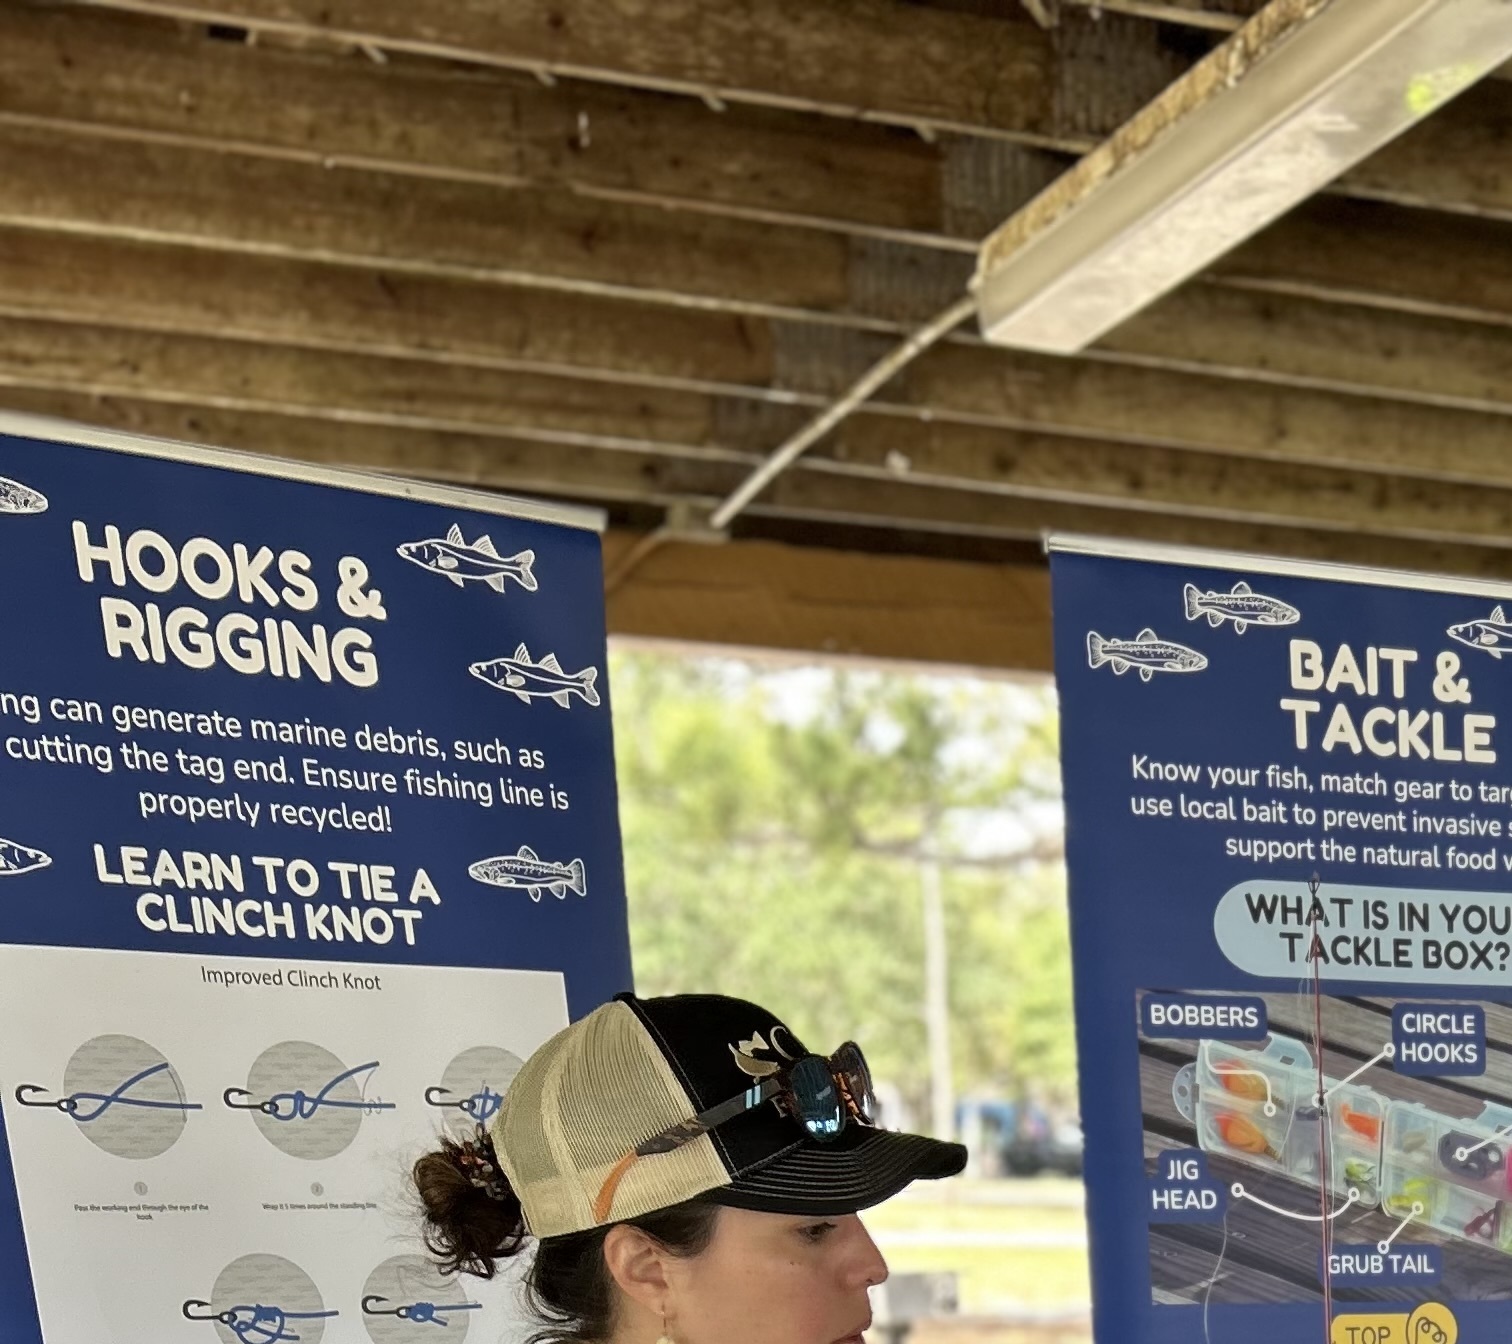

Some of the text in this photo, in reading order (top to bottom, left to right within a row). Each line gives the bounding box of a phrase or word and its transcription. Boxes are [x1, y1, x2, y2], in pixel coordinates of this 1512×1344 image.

[72, 522, 386, 621] HOOKS &
[101, 598, 378, 687] RIGGING
[1290, 640, 1471, 703] BAIT &
[50, 696, 544, 768] can generate marine debris, such as
[1281, 699, 1496, 763] TACKLE
[6, 734, 568, 810] cutting the tag end. Ensure fishing line is
[1132, 755, 1200, 782] Know
[1208, 764, 1259, 791] your
[1267, 765, 1313, 793] fish,
[1321, 772, 1387, 796] match
[1394, 778, 1443, 801] gear
[1449, 777, 1472, 801] to
[140, 791, 392, 833] properly recycled!
[1131, 799, 1172, 817] use
[1180, 797, 1236, 821] local
[1243, 800, 1288, 823] bait
[1293, 803, 1316, 825] to
[1324, 808, 1406, 833] prevent
[1413, 813, 1501, 837] invasive
[94, 844, 440, 904] LEARN TO TIE A
[1226, 837, 1314, 864] support
[1321, 839, 1356, 862] the
[1363, 843, 1440, 868] natural
[1446, 847, 1496, 871] food
[136, 893, 422, 945] CLINCH KNOT
[1245, 893, 1354, 929] WHAT
[1363, 900, 1389, 931] IS
[1399, 902, 1430, 932] IN
[1280, 932, 1510, 972] TACKLE BOX?
[201, 966, 382, 991] Improved Clinch Knot
[1150, 1005, 1258, 1028] BOBBERS
[1402, 1013, 1476, 1035] CIRCLE
[1401, 1043, 1477, 1064] HOOKS
[1167, 1160, 1198, 1181] JIG
[1152, 1189, 1216, 1211] HEAD
[1327, 1254, 1434, 1275] GRUB TAIL
